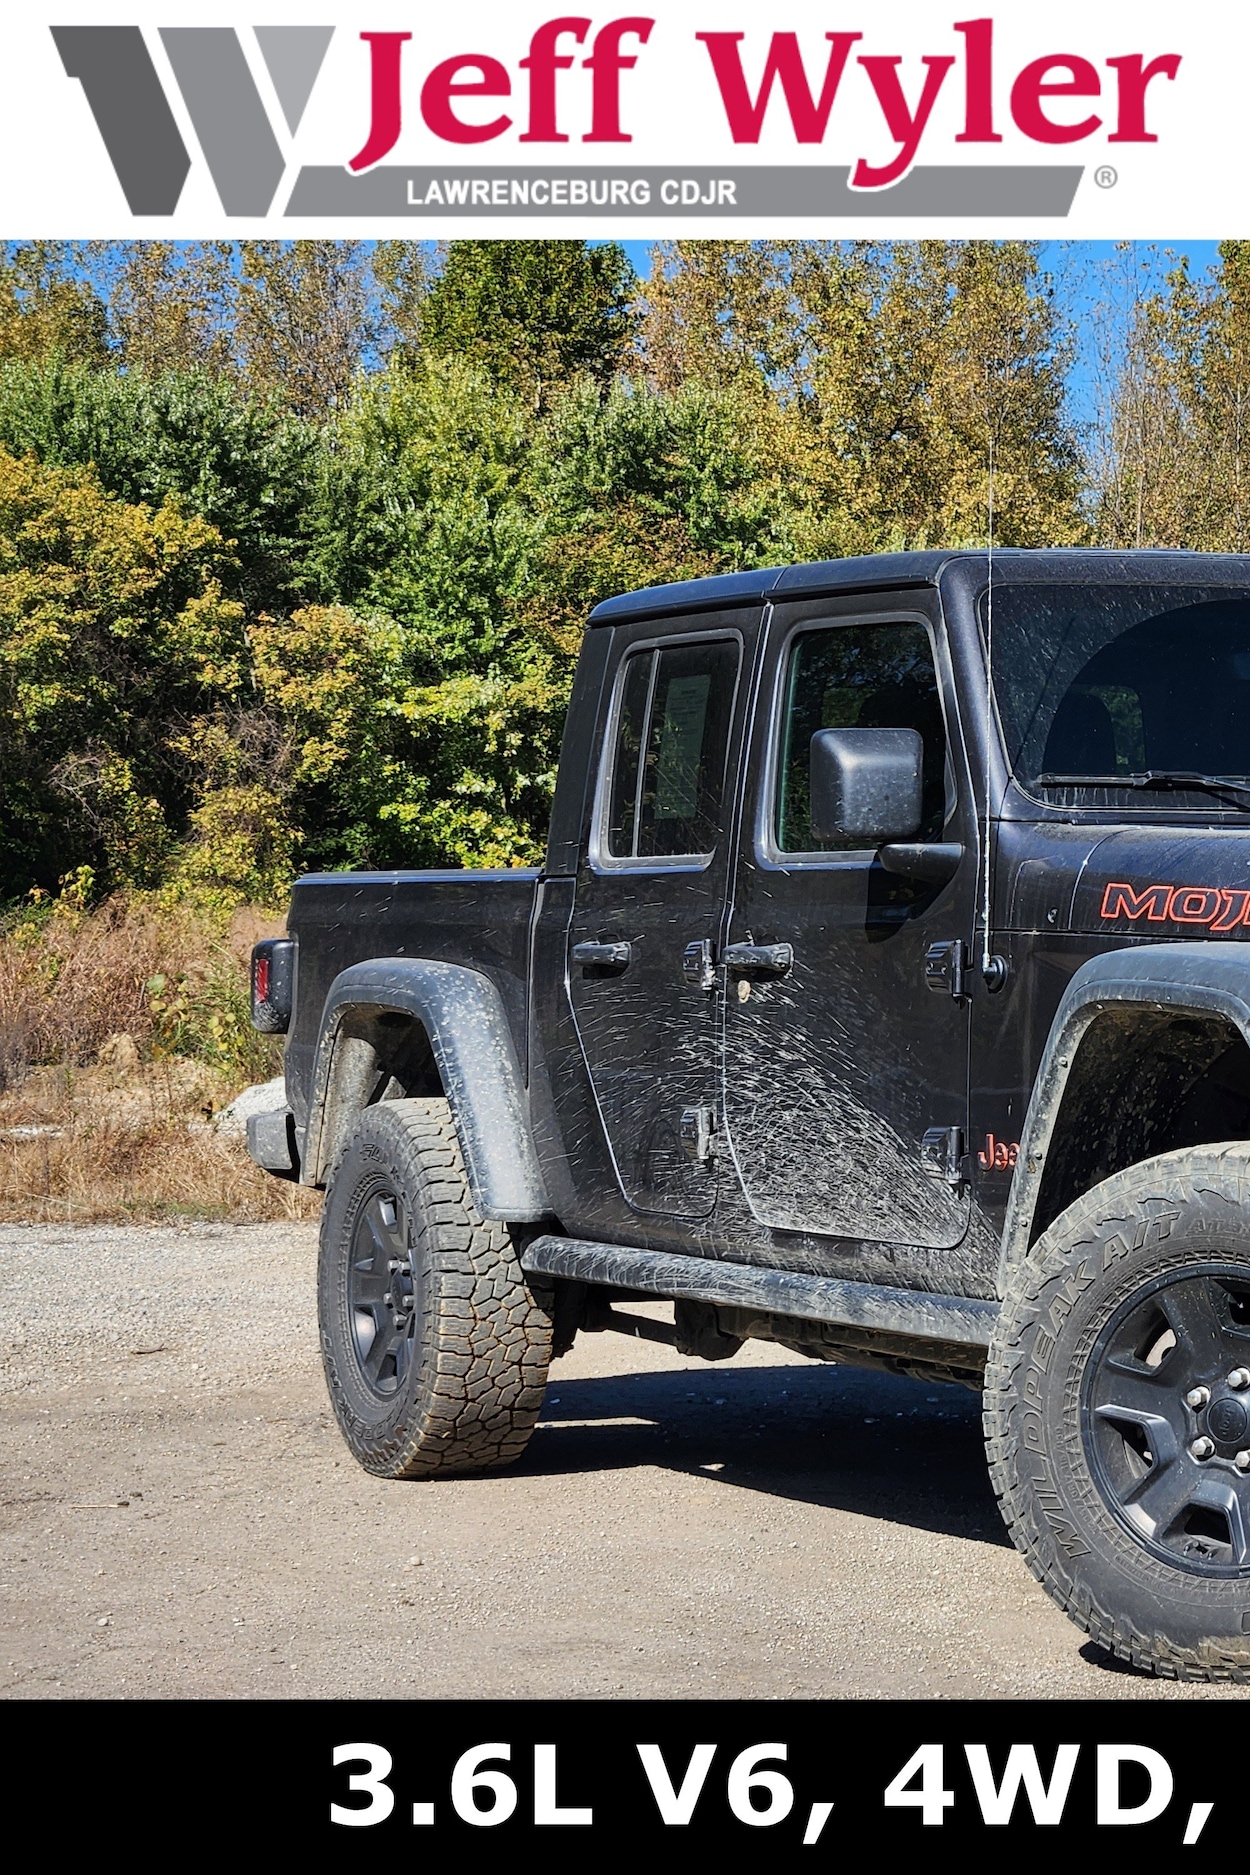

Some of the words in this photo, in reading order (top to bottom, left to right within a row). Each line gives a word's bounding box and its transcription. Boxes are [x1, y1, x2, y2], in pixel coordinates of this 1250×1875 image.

[977, 1133, 1021, 1171] Jee
[1023, 1257, 1096, 1558] WILDPEAK
[1102, 1209, 1182, 1273] A/T
